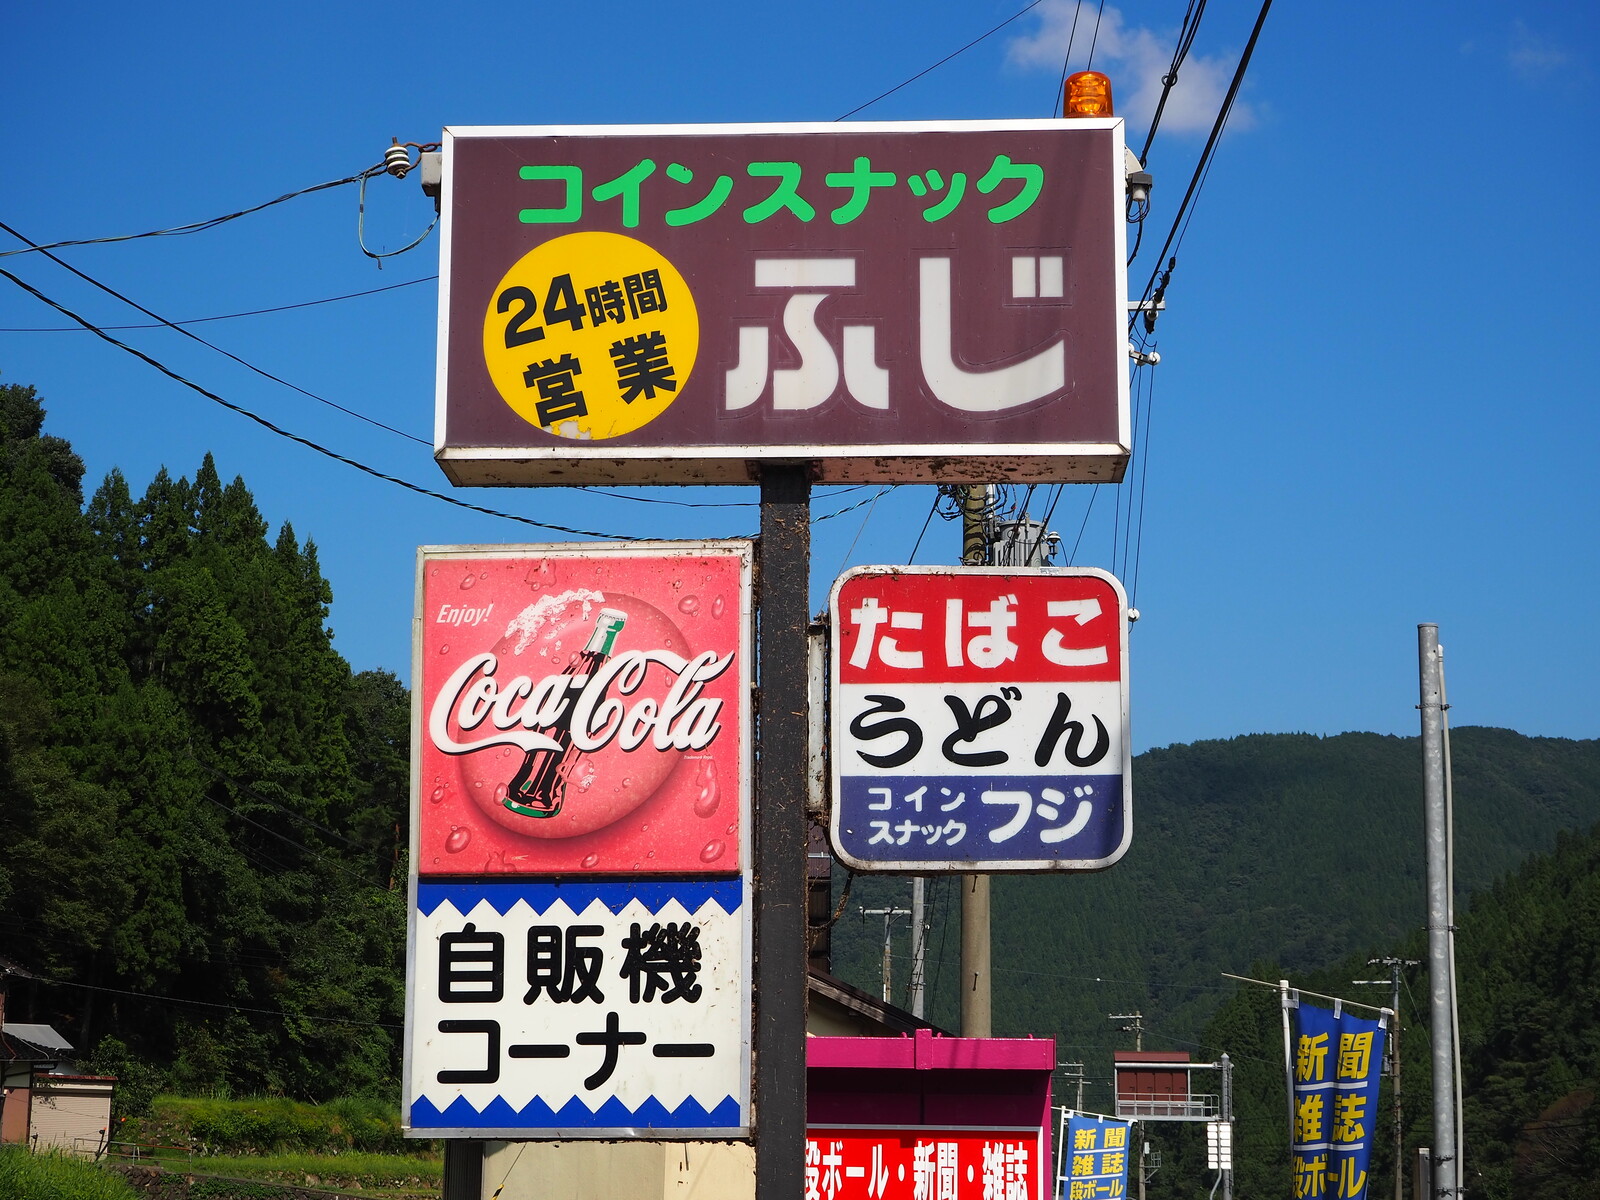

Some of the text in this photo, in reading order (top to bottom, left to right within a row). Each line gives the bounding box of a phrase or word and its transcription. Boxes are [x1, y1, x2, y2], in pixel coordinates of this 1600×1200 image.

[518, 154, 1045, 228] コインスナック
[496, 268, 668, 349] 24時間
[725, 256, 1066, 412] ふじ
[522, 330, 677, 427] 営業
[436, 603, 494, 627] Enjoy!
[849, 593, 1108, 669] たばこ
[429, 649, 736, 755] Coca-Cola
[849, 686, 1110, 768] うどん
[867, 785, 966, 812] コイン
[867, 819, 967, 845] スナック
[981, 784, 1094, 844] フジ
[438, 922, 703, 1005] 自販機
[437, 1011, 716, 1091] コーナー
[1295, 1031, 1374, 1082] 新聞
[1074, 1127, 1126, 1150] 新聞
[1294, 1093, 1367, 1142] 雑誌
[1069, 1178, 1124, 1200] 段ボール
[1071, 1152, 1125, 1176] 雑誌
